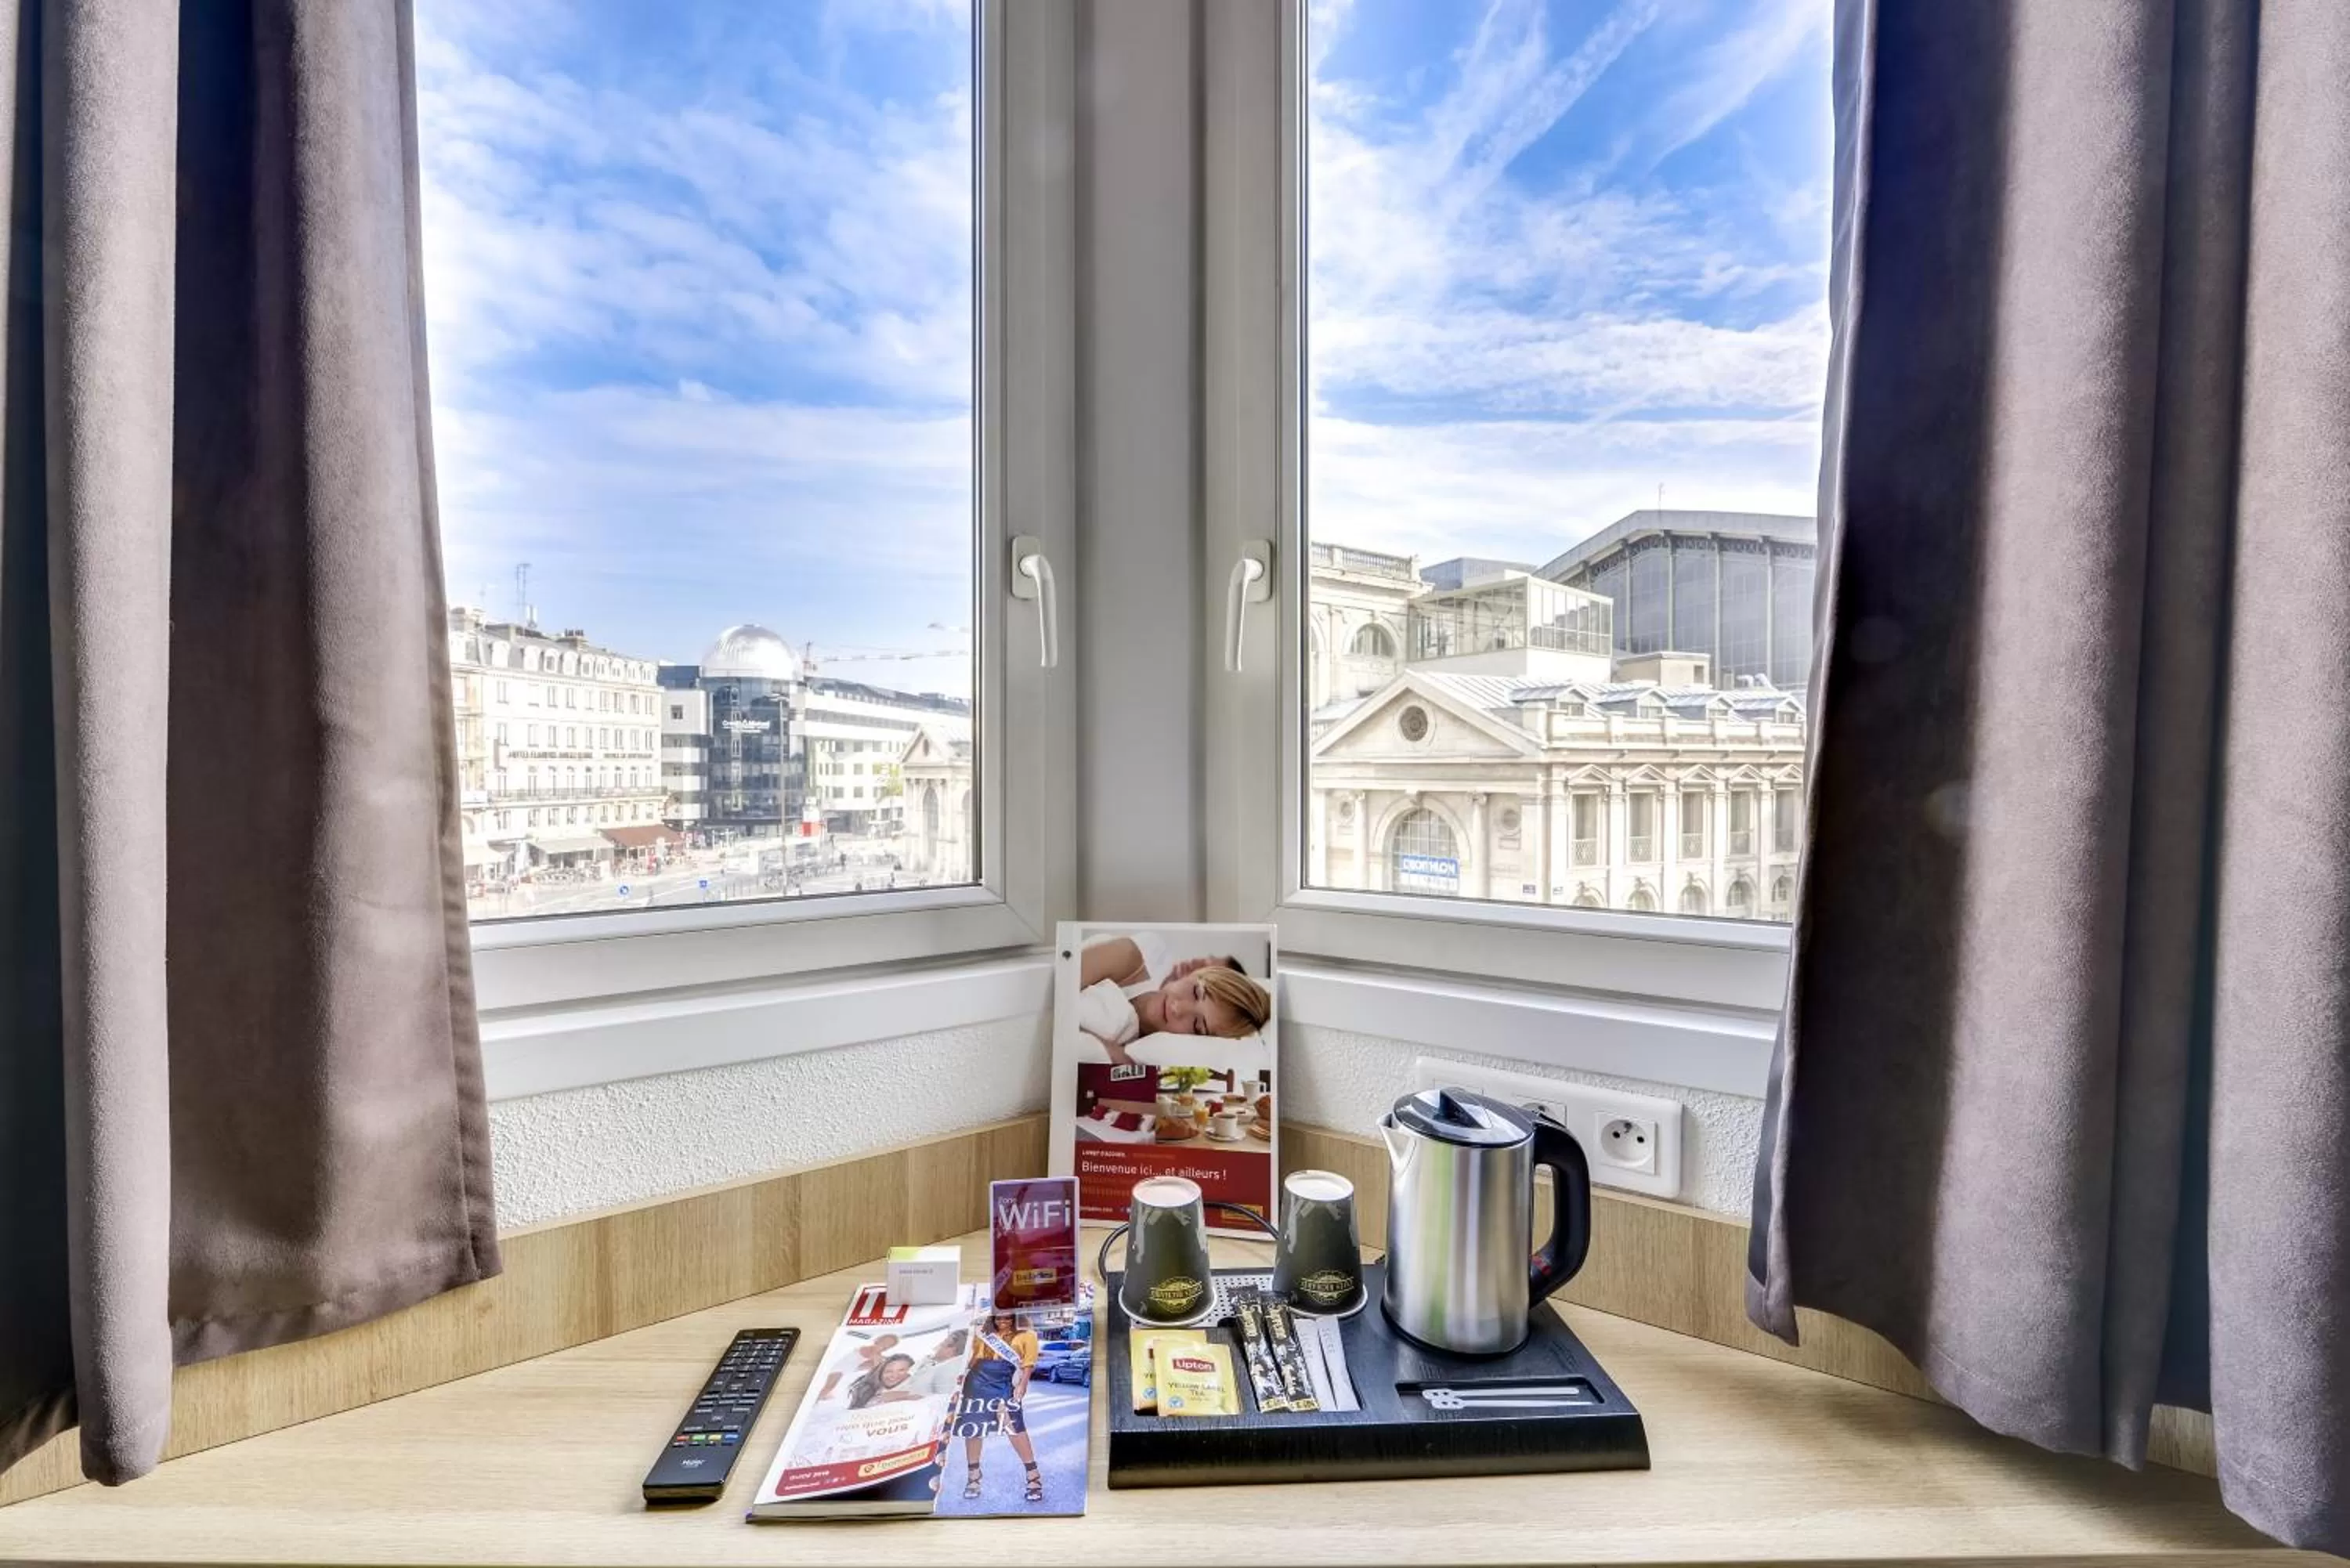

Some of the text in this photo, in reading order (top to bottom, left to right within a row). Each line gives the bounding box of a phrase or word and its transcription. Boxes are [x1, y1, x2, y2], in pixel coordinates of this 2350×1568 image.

[1082, 1160, 1137, 1175] Bienvenue
[1179, 1165, 1220, 1180] ailleurs
[999, 1200, 1071, 1231] WiFi
[1176, 1358, 1212, 1371] Lipton
[955, 1412, 1018, 1440] ork
